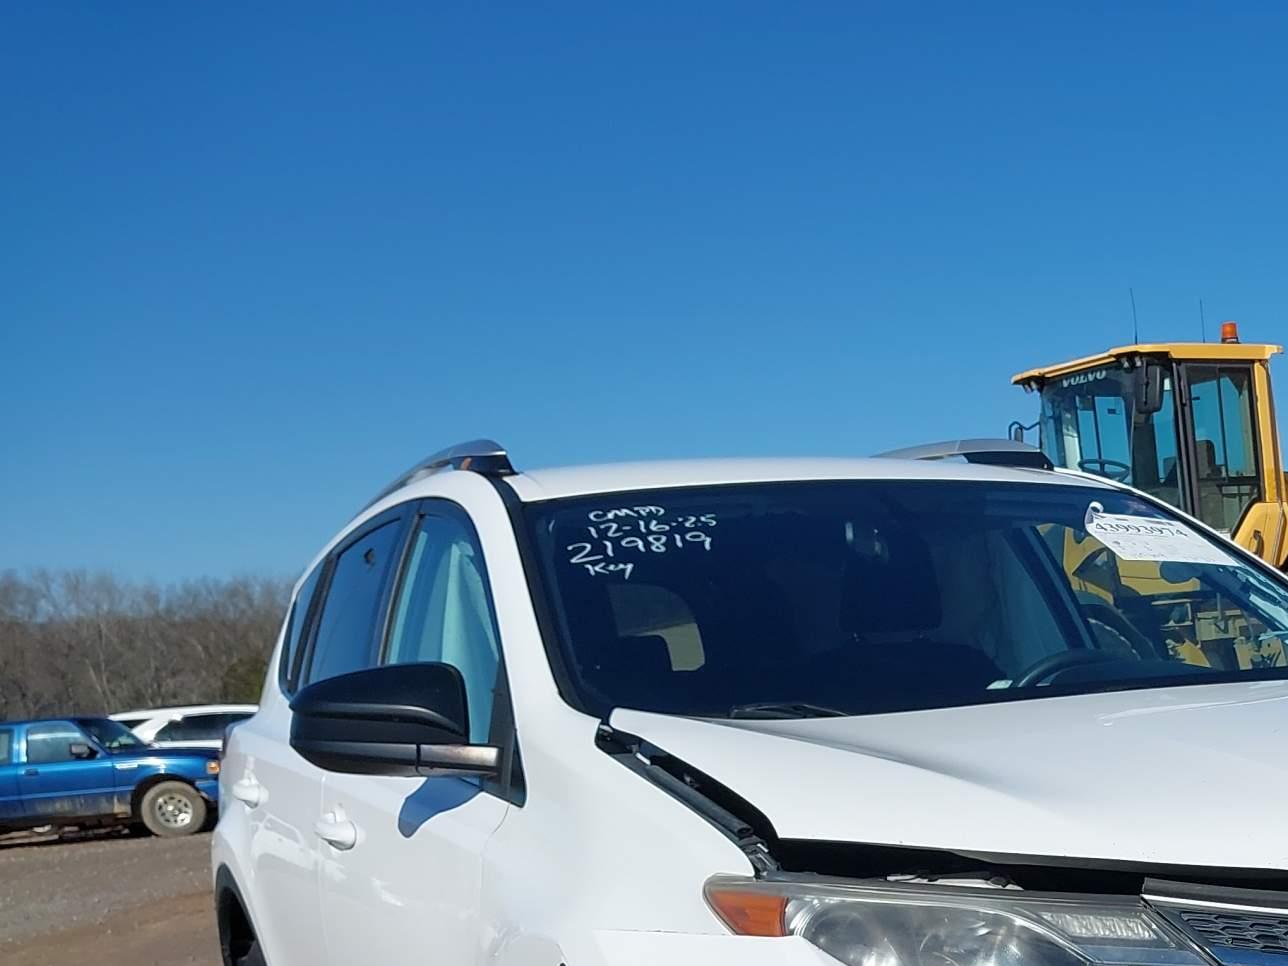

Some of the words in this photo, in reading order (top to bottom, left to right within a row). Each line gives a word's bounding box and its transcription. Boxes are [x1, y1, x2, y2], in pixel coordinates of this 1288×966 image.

[1062, 369, 1107, 388] VOLVO
[1095, 522, 1188, 537] 43993974
[567, 531, 713, 563] 219819
